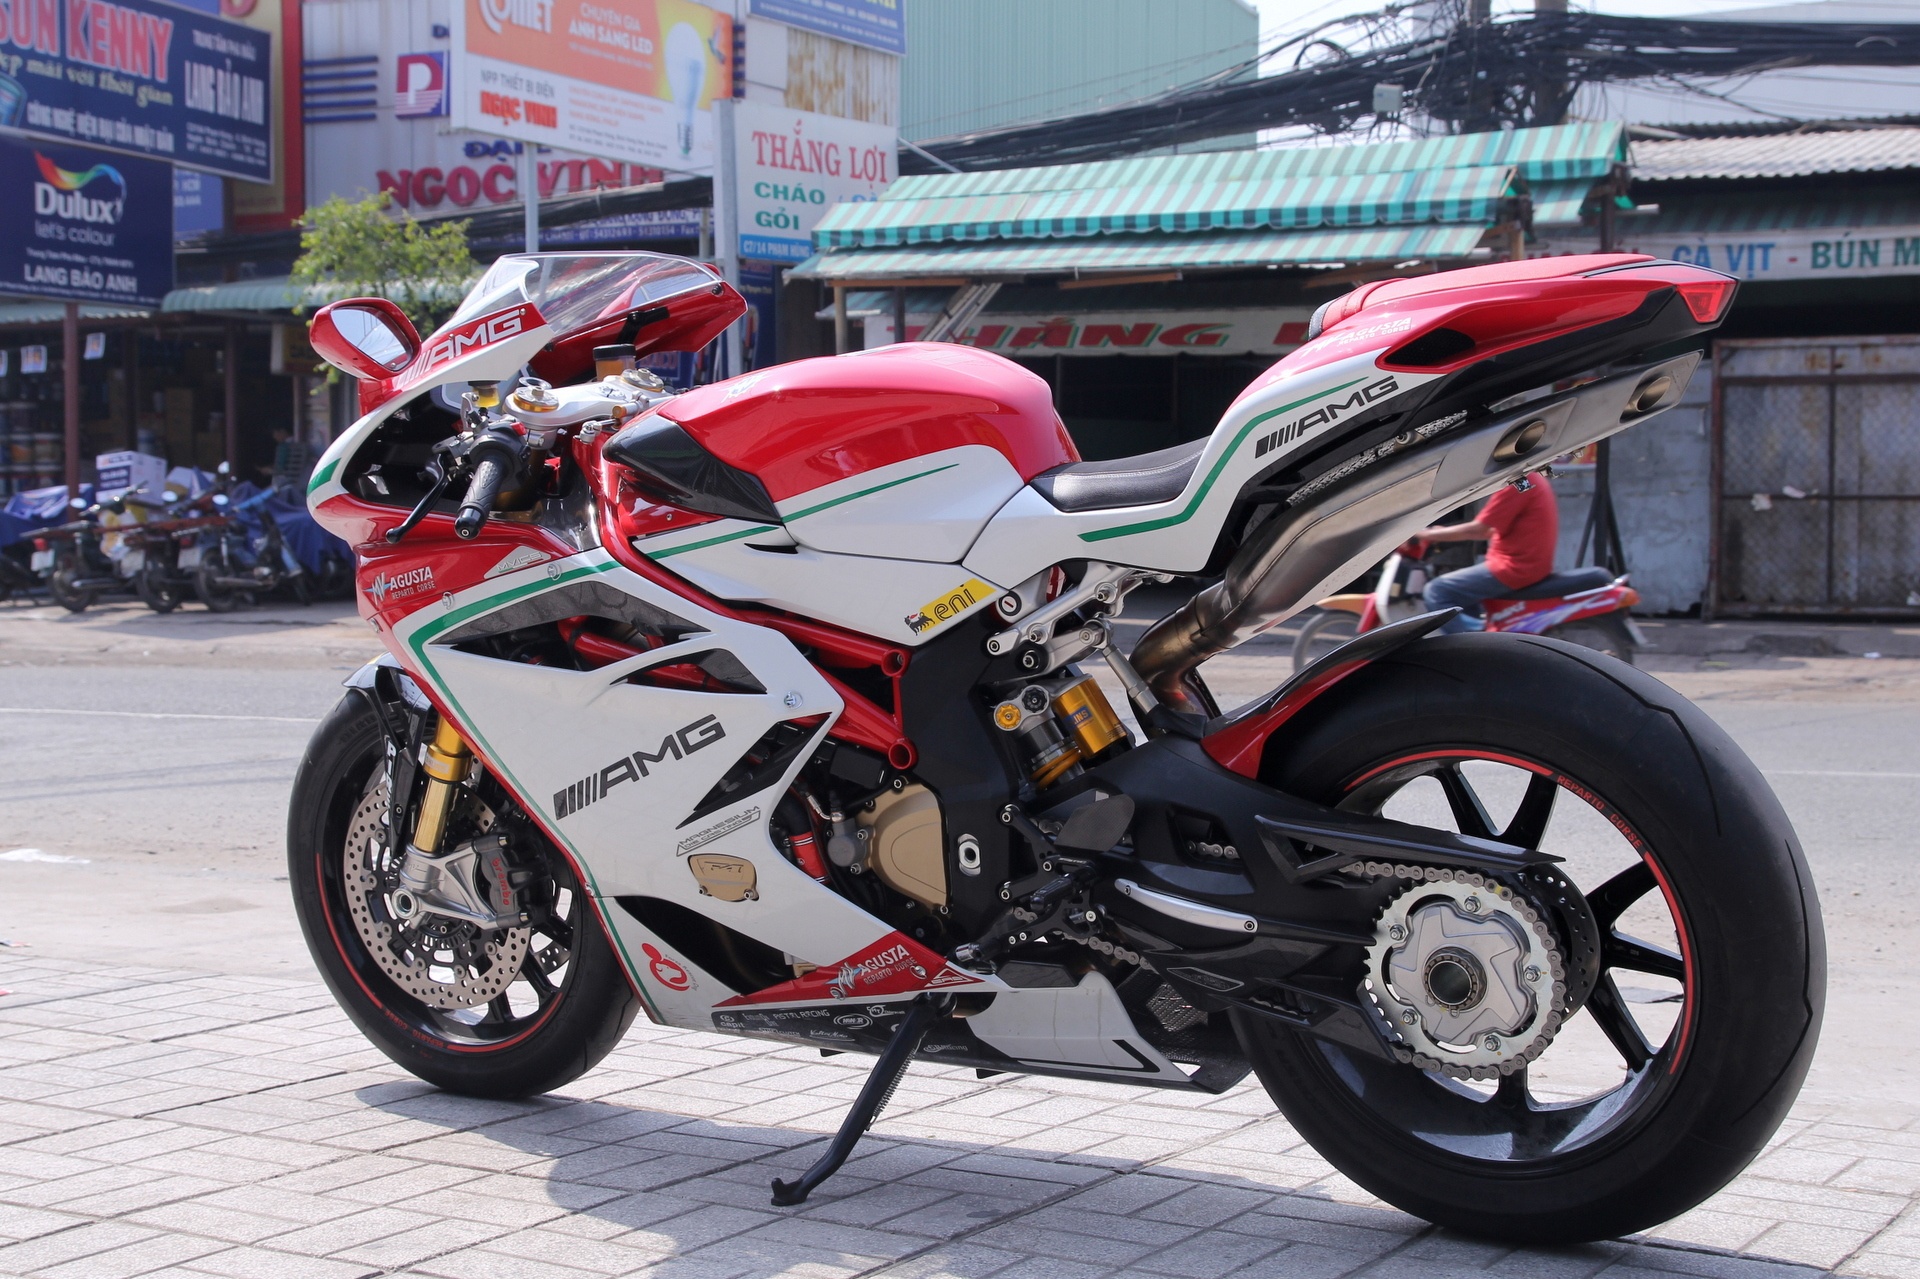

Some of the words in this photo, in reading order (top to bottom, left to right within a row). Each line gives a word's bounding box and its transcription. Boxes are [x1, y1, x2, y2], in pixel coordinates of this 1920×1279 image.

[65, 0, 175, 84] KENNY
[463, 138, 524, 162] ĐẠI
[751, 118, 842, 177] THẮNG
[848, 145, 888, 190] LỢI
[34, 181, 116, 225] Dulux
[754, 181, 826, 205] CHÁO
[755, 206, 800, 230] GỎI
[1725, 242, 1776, 279] VỊT
[1811, 231, 1880, 269] BÚN
[24, 262, 68, 286] LANG
[70, 265, 104, 291] BẢO
[105, 273, 138, 293] ANH
[424, 309, 523, 373] AMG
[1381, 323, 1411, 336] CORSE
[1296, 375, 1400, 438] AMG
[389, 566, 434, 588] AGUSTA
[391, 587, 415, 600] REPARTO
[417, 581, 436, 593] CORSE
[933, 583, 977, 622] eni
[599, 713, 727, 800] AMG
[1556, 774, 1607, 811] REPARTO
[679, 805, 761, 846] MAGNESIUM
[1609, 813, 1644, 849] CORSE
[491, 857, 513, 906] brembo
[858, 943, 911, 977] AGUSTA
[863, 969, 893, 985] REPARTO
[894, 956, 918, 974] CORSE
[720, 1021, 745, 1029] capit
